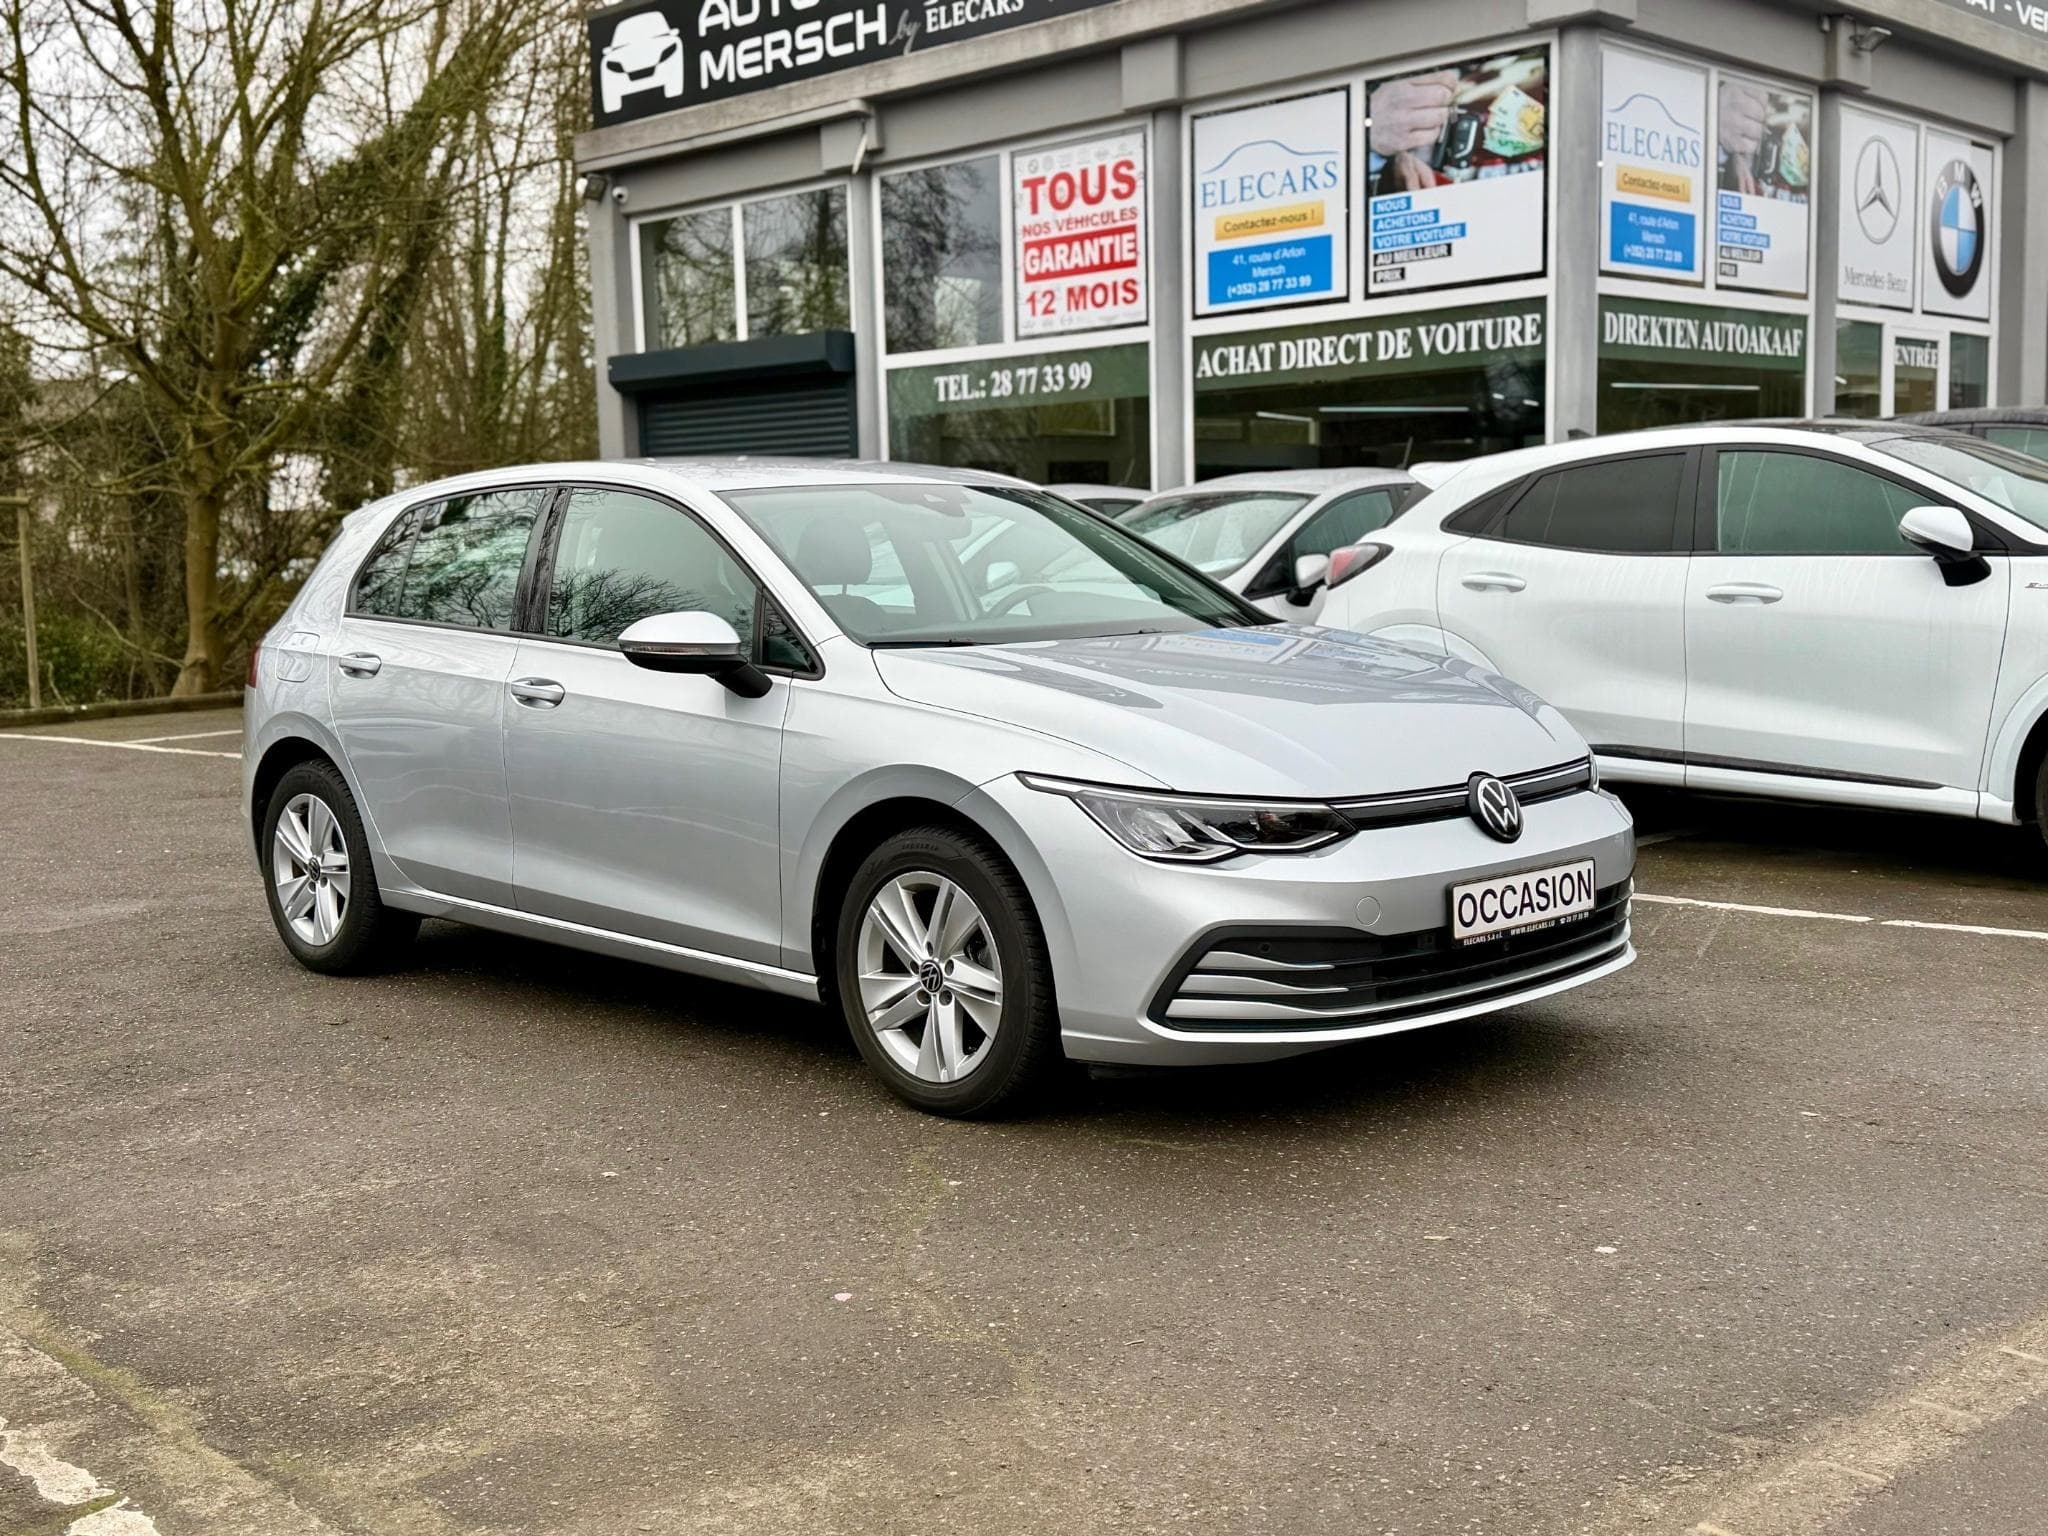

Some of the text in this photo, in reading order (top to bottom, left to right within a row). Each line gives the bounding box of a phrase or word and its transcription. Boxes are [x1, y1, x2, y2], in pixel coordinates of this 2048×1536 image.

[698, 0, 821, 37] AU
[888, 9, 921, 56] by
[2015, 0, 2048, 32] VE
[700, 3, 887, 90] MERSCH
[1606, 121, 1701, 168] ELECARS
[1022, 160, 1137, 215] TOUS
[1201, 160, 1338, 208] ELECARS
[1935, 160, 1982, 210] BMW
[1223, 211, 1308, 233] Contactez-nous
[1376, 197, 1408, 213] NOUS
[1376, 211, 1436, 230] ACHETONS
[1022, 222, 1051, 238] NOS
[1375, 225, 1461, 248] VOTRE VOITURE
[1025, 233, 1136, 275] GARANTIE
[1376, 251, 1392, 266] AU
[1026, 279, 1138, 316] 12 MOIS
[1196, 313, 1543, 378] ACHAT DIRECT DE VOITURE
[1604, 311, 1804, 357] DIREKTEN AUTOAKAAF
[1895, 342, 1938, 369] ENTRÉE
[934, 361, 1093, 402] TEL.: 28 77 33 99
[1458, 868, 1592, 928] OCCASION
[1463, 936, 1486, 946] ELECARS
